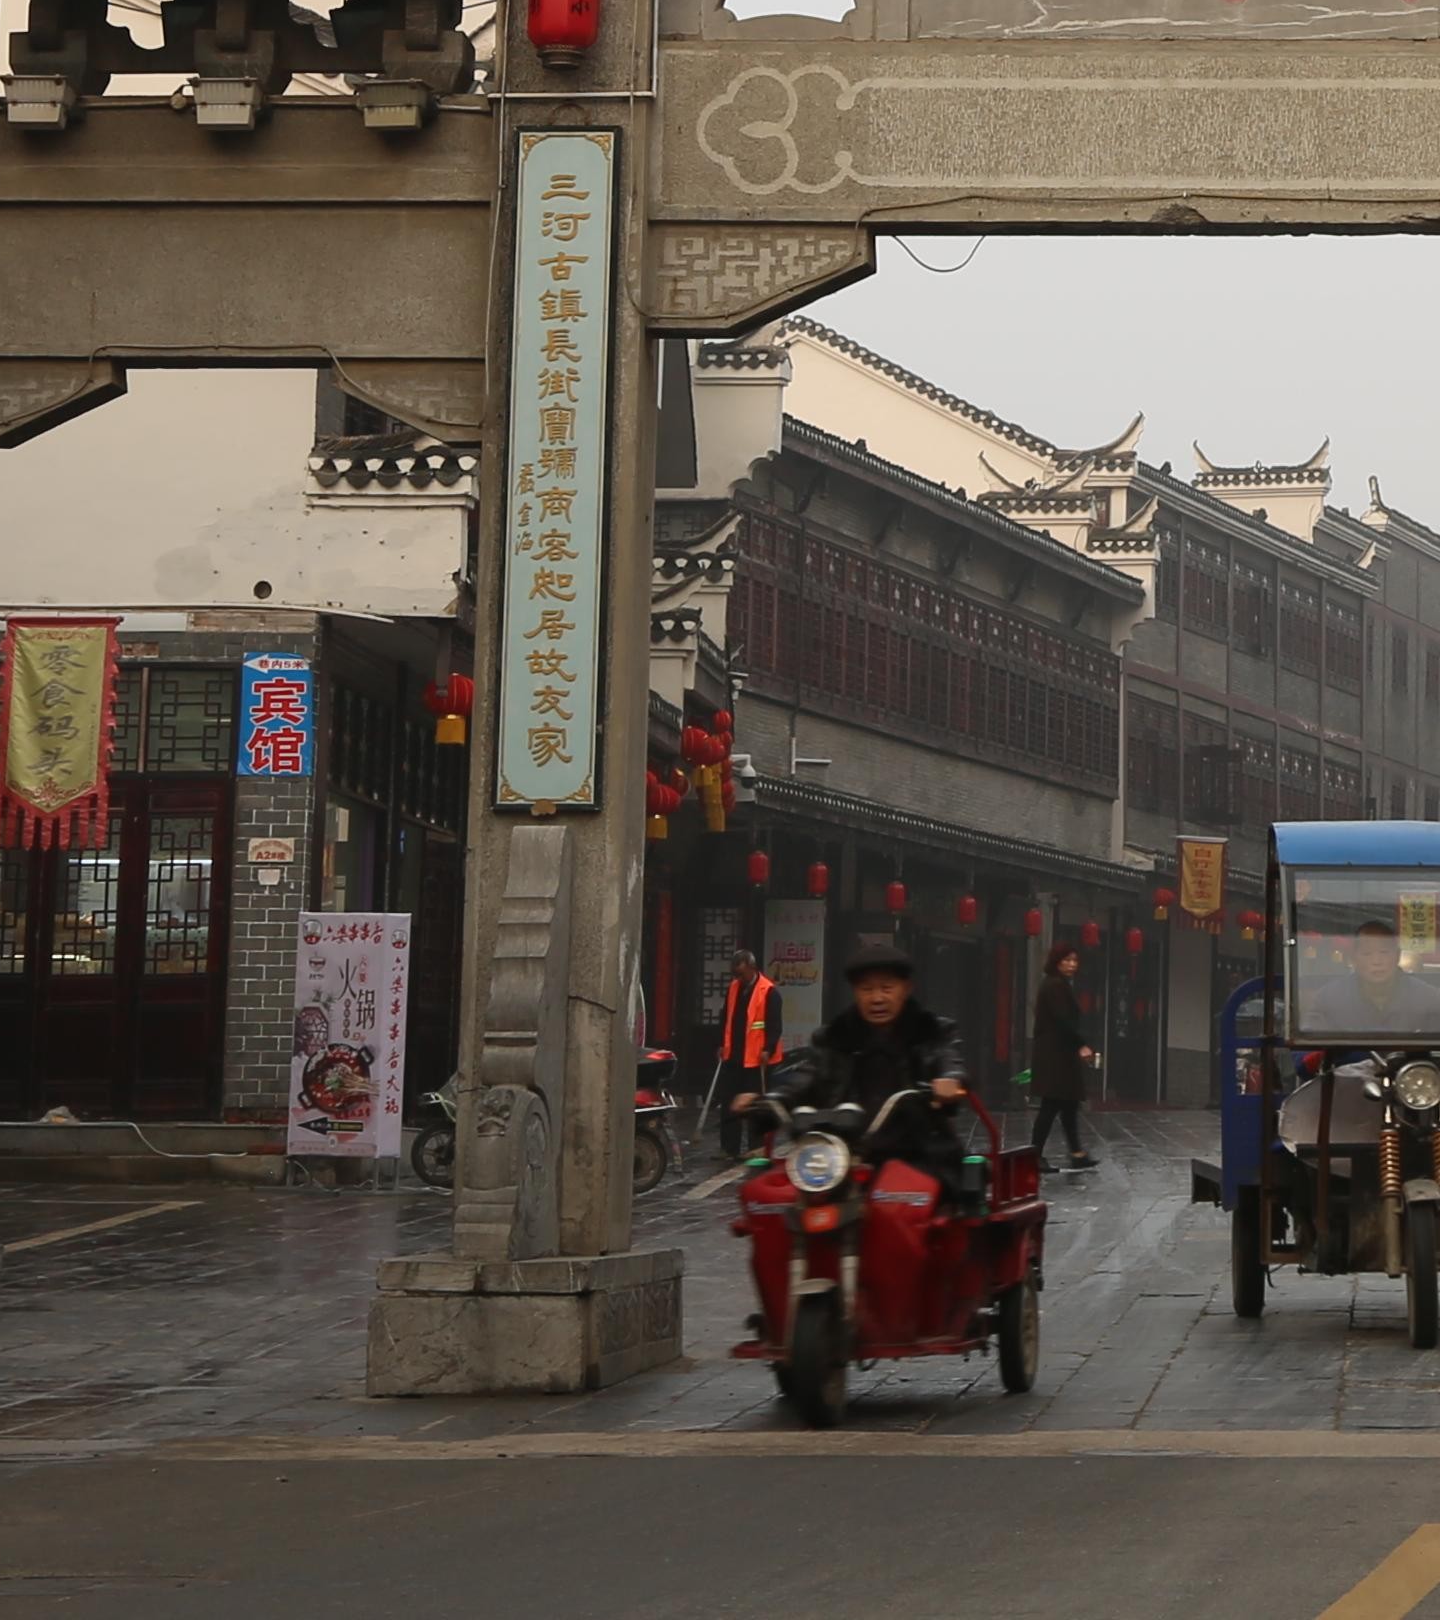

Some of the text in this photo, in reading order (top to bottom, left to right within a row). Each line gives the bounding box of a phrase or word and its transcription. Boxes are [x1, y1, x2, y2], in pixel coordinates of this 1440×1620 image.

[27, 645, 88, 776] 零食码头
[245, 677, 307, 774] 宾馆
[338, 958, 376, 1030] 火锅
